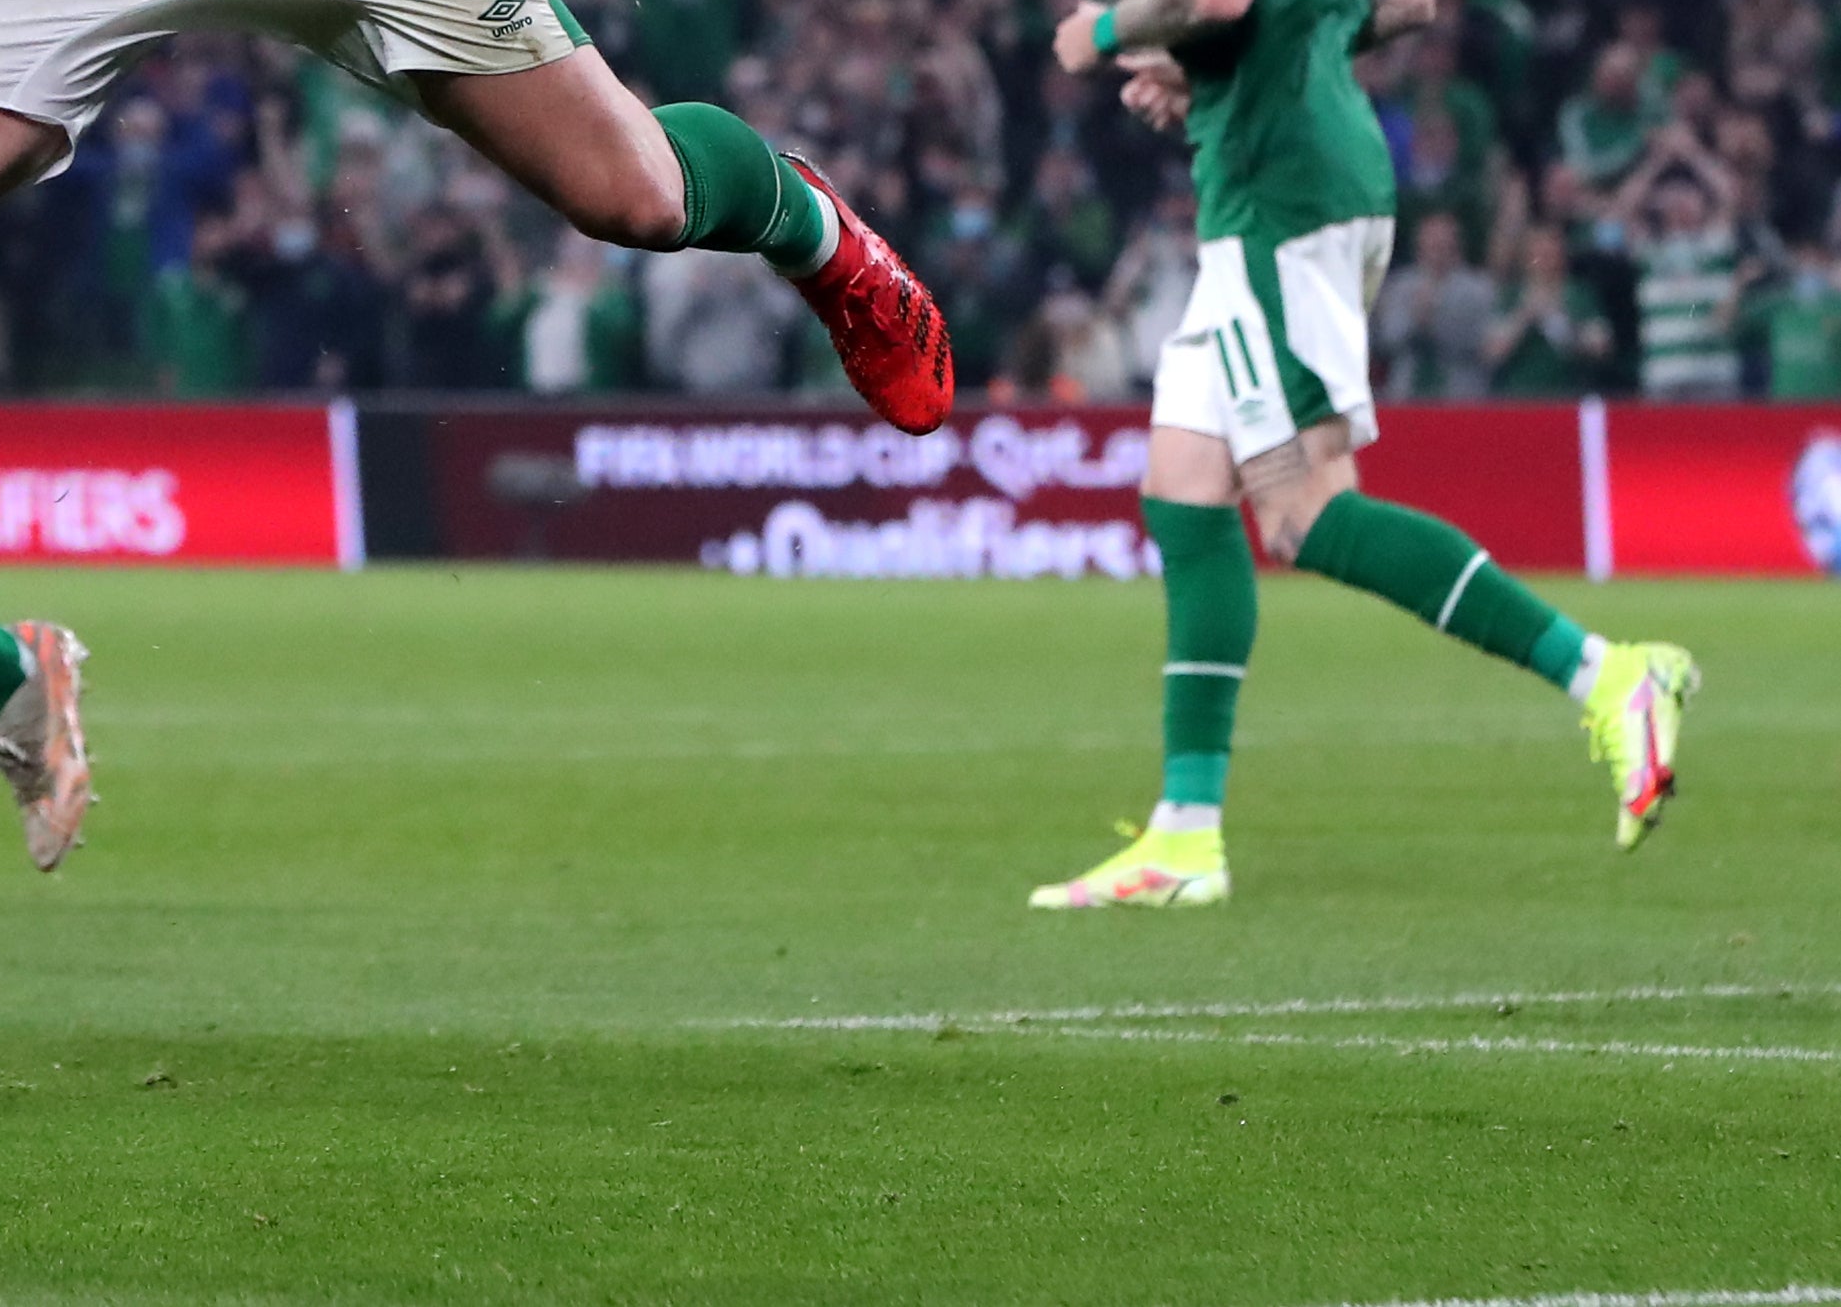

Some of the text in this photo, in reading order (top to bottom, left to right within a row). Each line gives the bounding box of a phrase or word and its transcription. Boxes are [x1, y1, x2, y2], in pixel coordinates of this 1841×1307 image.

[492, 16, 533, 38] umbro
[1214, 318, 1260, 400] 11
[678, 423, 859, 489] WORLD
[763, 497, 1139, 580] Qualifiers
